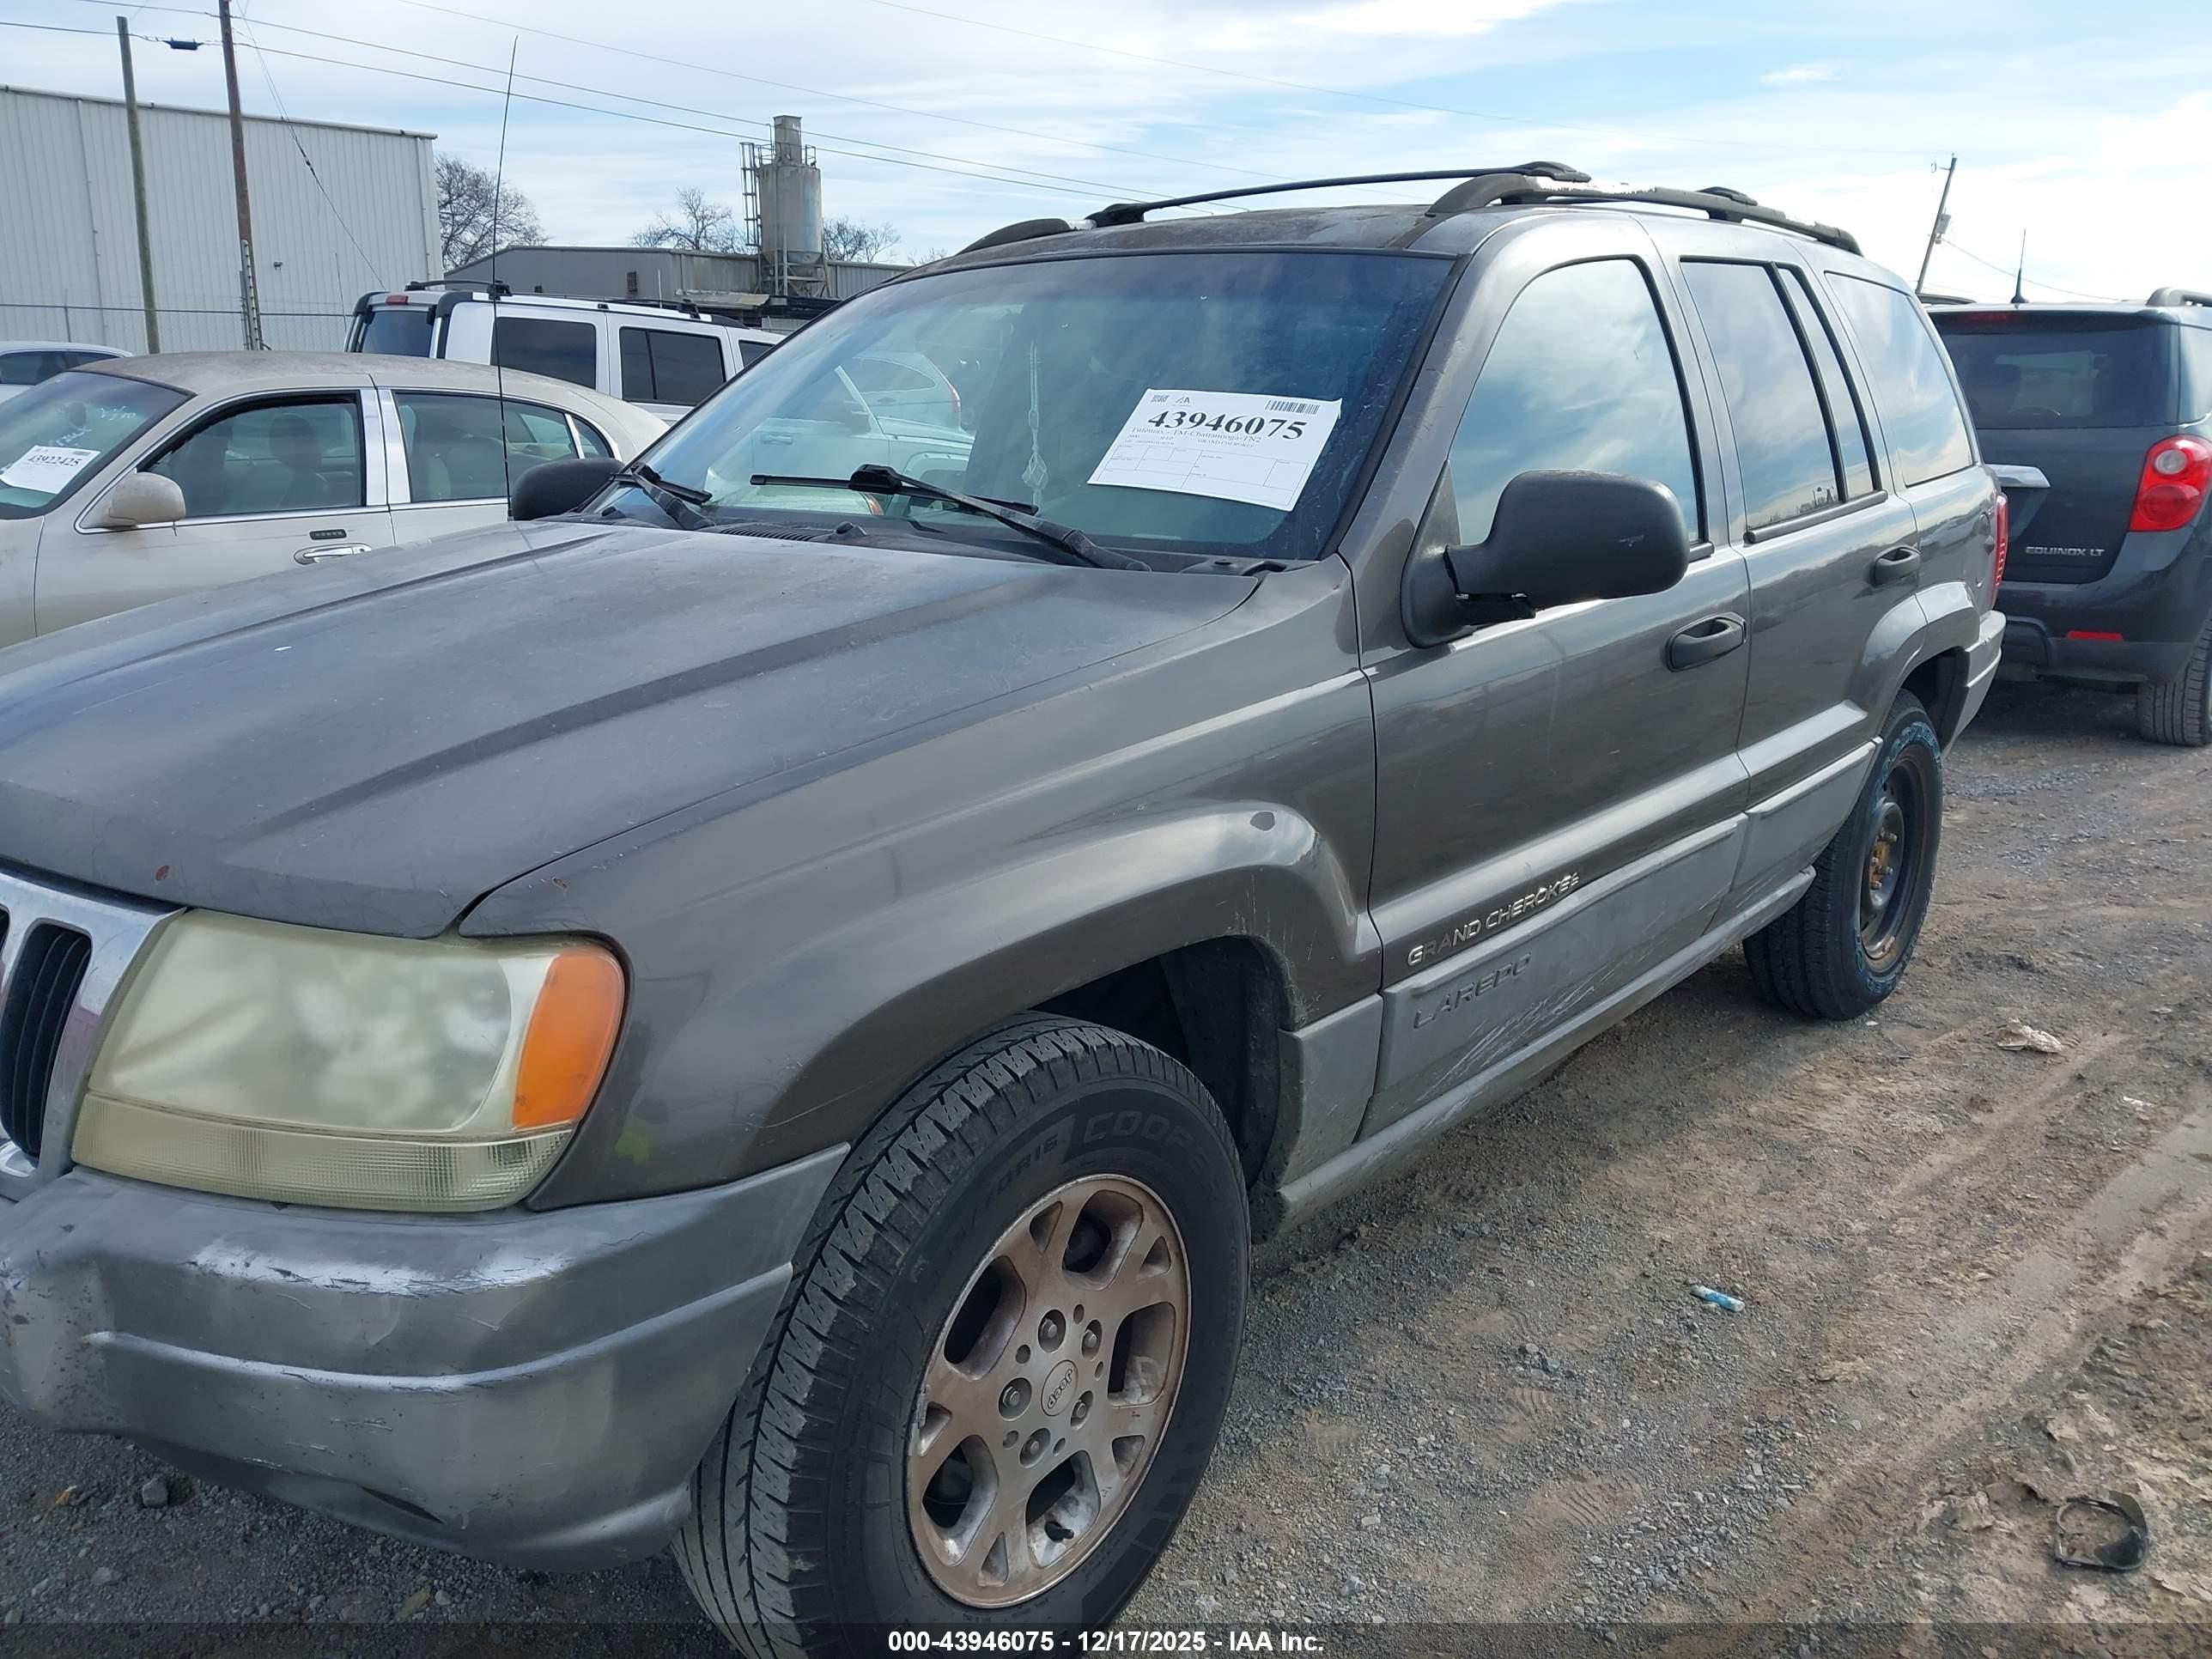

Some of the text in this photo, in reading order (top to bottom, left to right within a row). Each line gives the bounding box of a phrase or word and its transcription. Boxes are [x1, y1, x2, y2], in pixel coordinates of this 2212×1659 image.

[1148, 410, 1307, 440] 43946075
[2026, 546, 2105, 556] EQUINOX LT
[1407, 919, 1481, 967] GRAND
[1413, 951, 1533, 1030] LAREDO
[1047, 1368, 1073, 1409] Jeep
